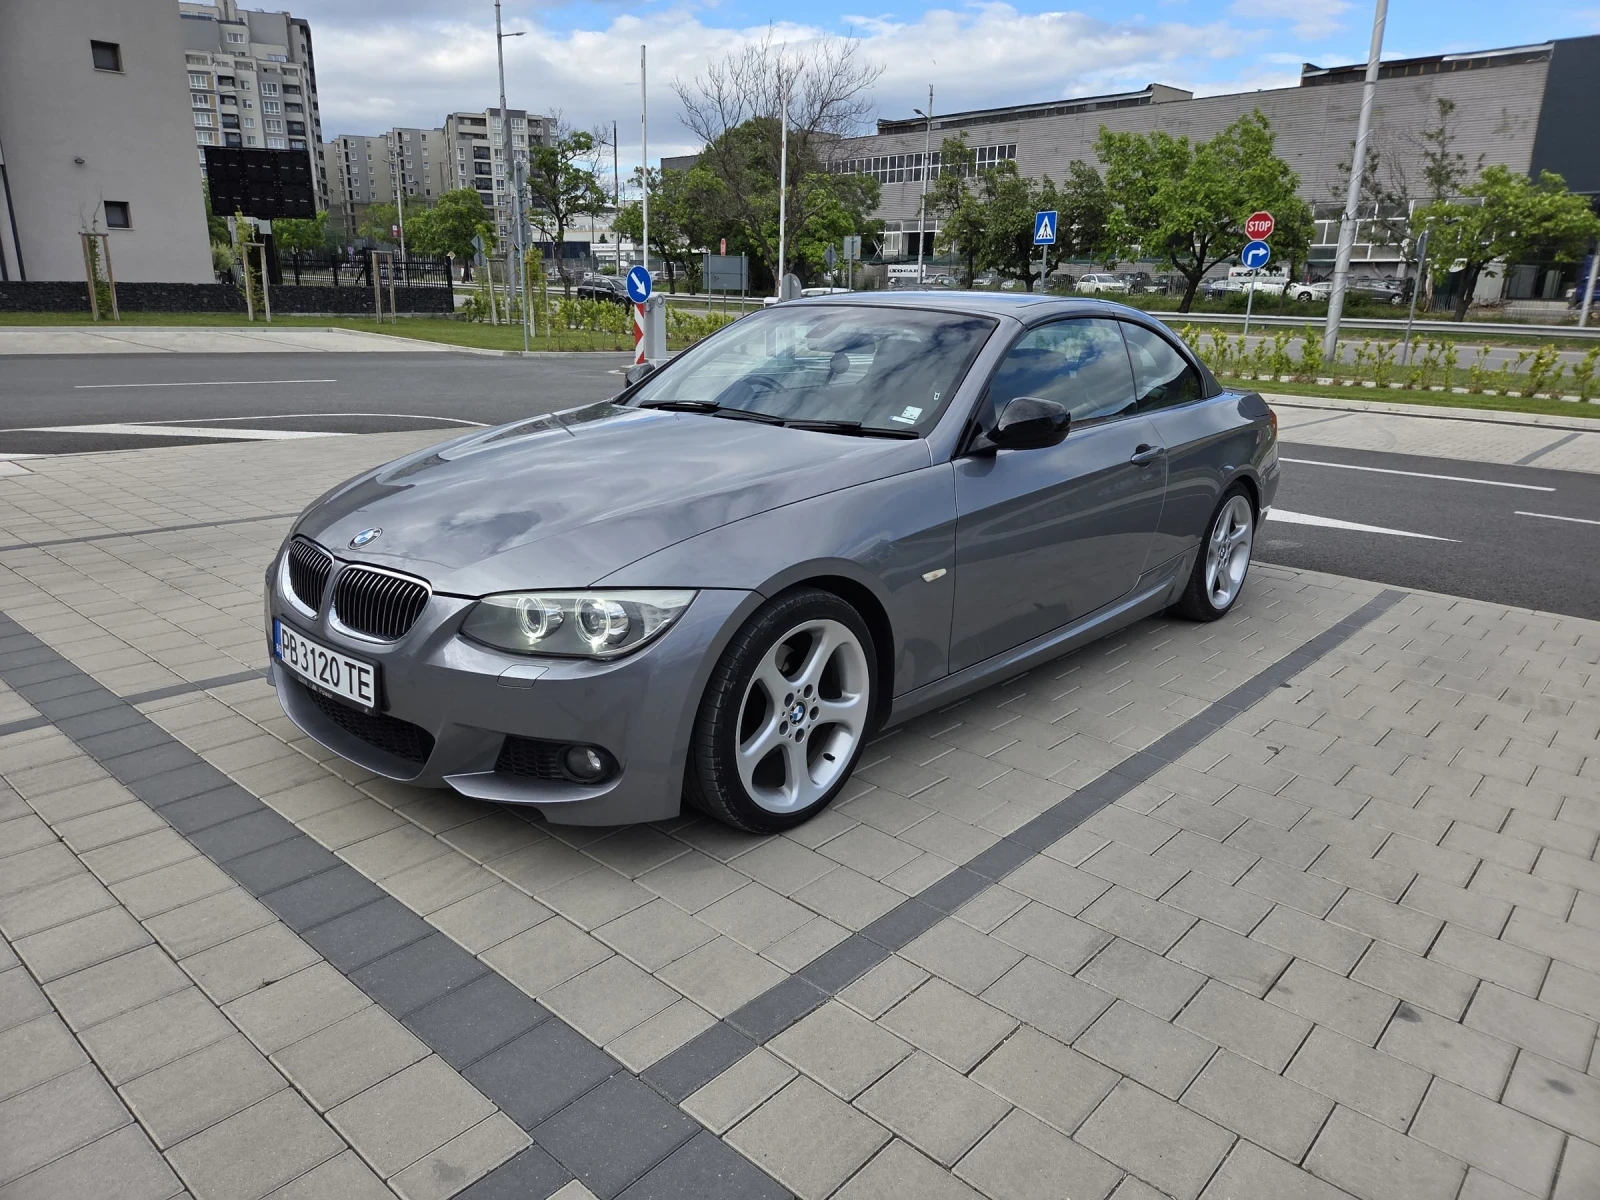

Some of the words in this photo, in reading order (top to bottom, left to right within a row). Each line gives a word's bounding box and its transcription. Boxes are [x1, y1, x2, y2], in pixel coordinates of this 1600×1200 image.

[1248, 221, 1271, 232] STOP
[301, 641, 340, 688] 3120
[344, 660, 372, 703] TE
